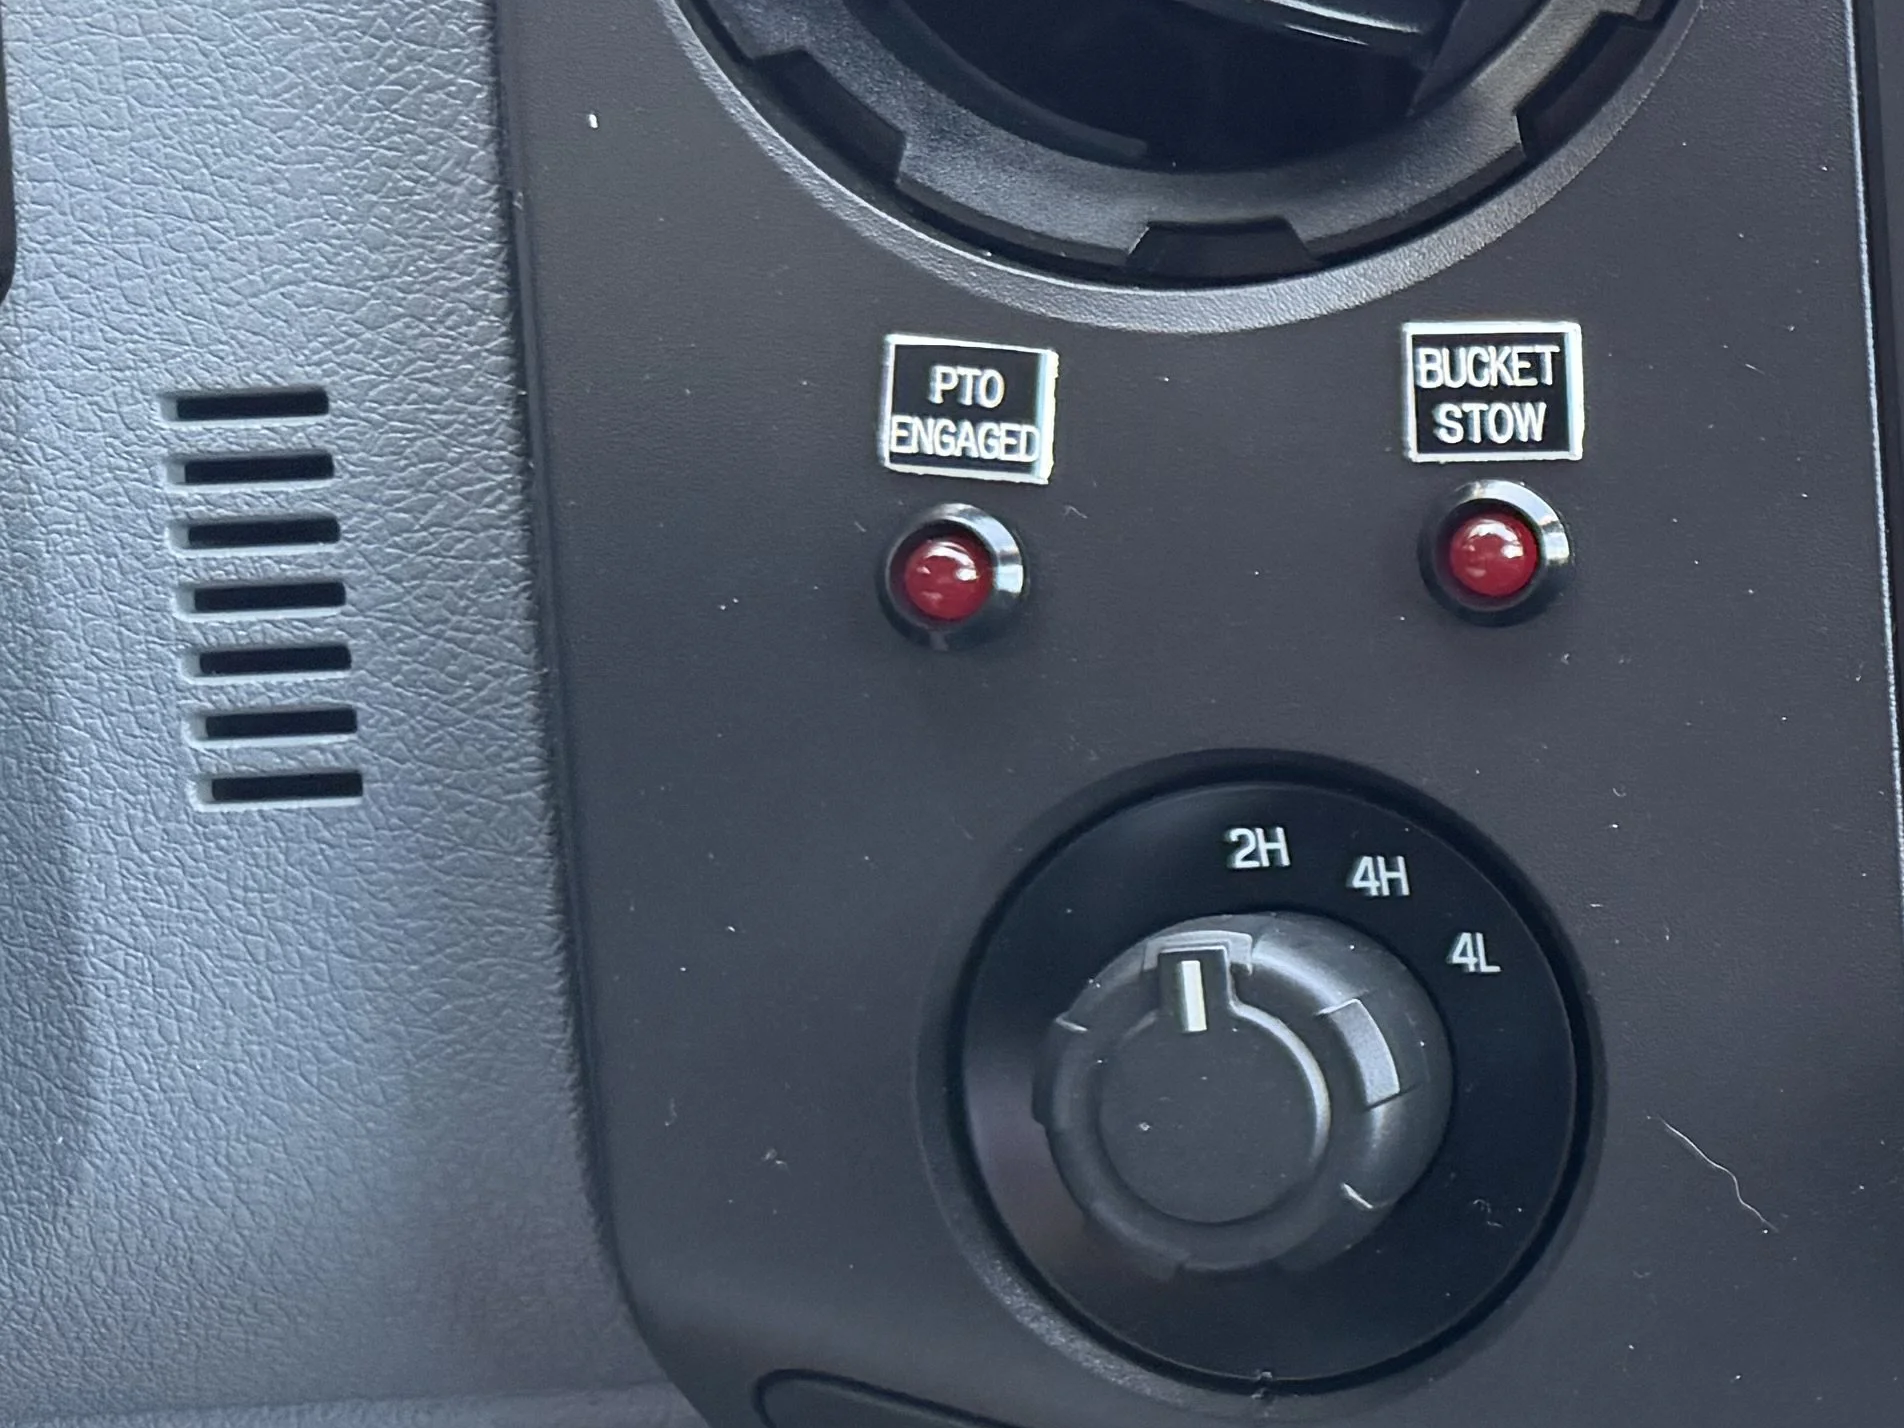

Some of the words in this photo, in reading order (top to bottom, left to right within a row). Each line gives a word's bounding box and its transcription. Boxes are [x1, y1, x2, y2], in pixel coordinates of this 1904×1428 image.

[928, 363, 1006, 410] PTO
[1415, 344, 1563, 390] BUCKET
[889, 415, 1042, 465] ENGAGED
[1433, 400, 1548, 445] STOW
[1225, 826, 1292, 870] 2H
[1349, 855, 1411, 898] 4H
[1448, 932, 1502, 974] 4L
